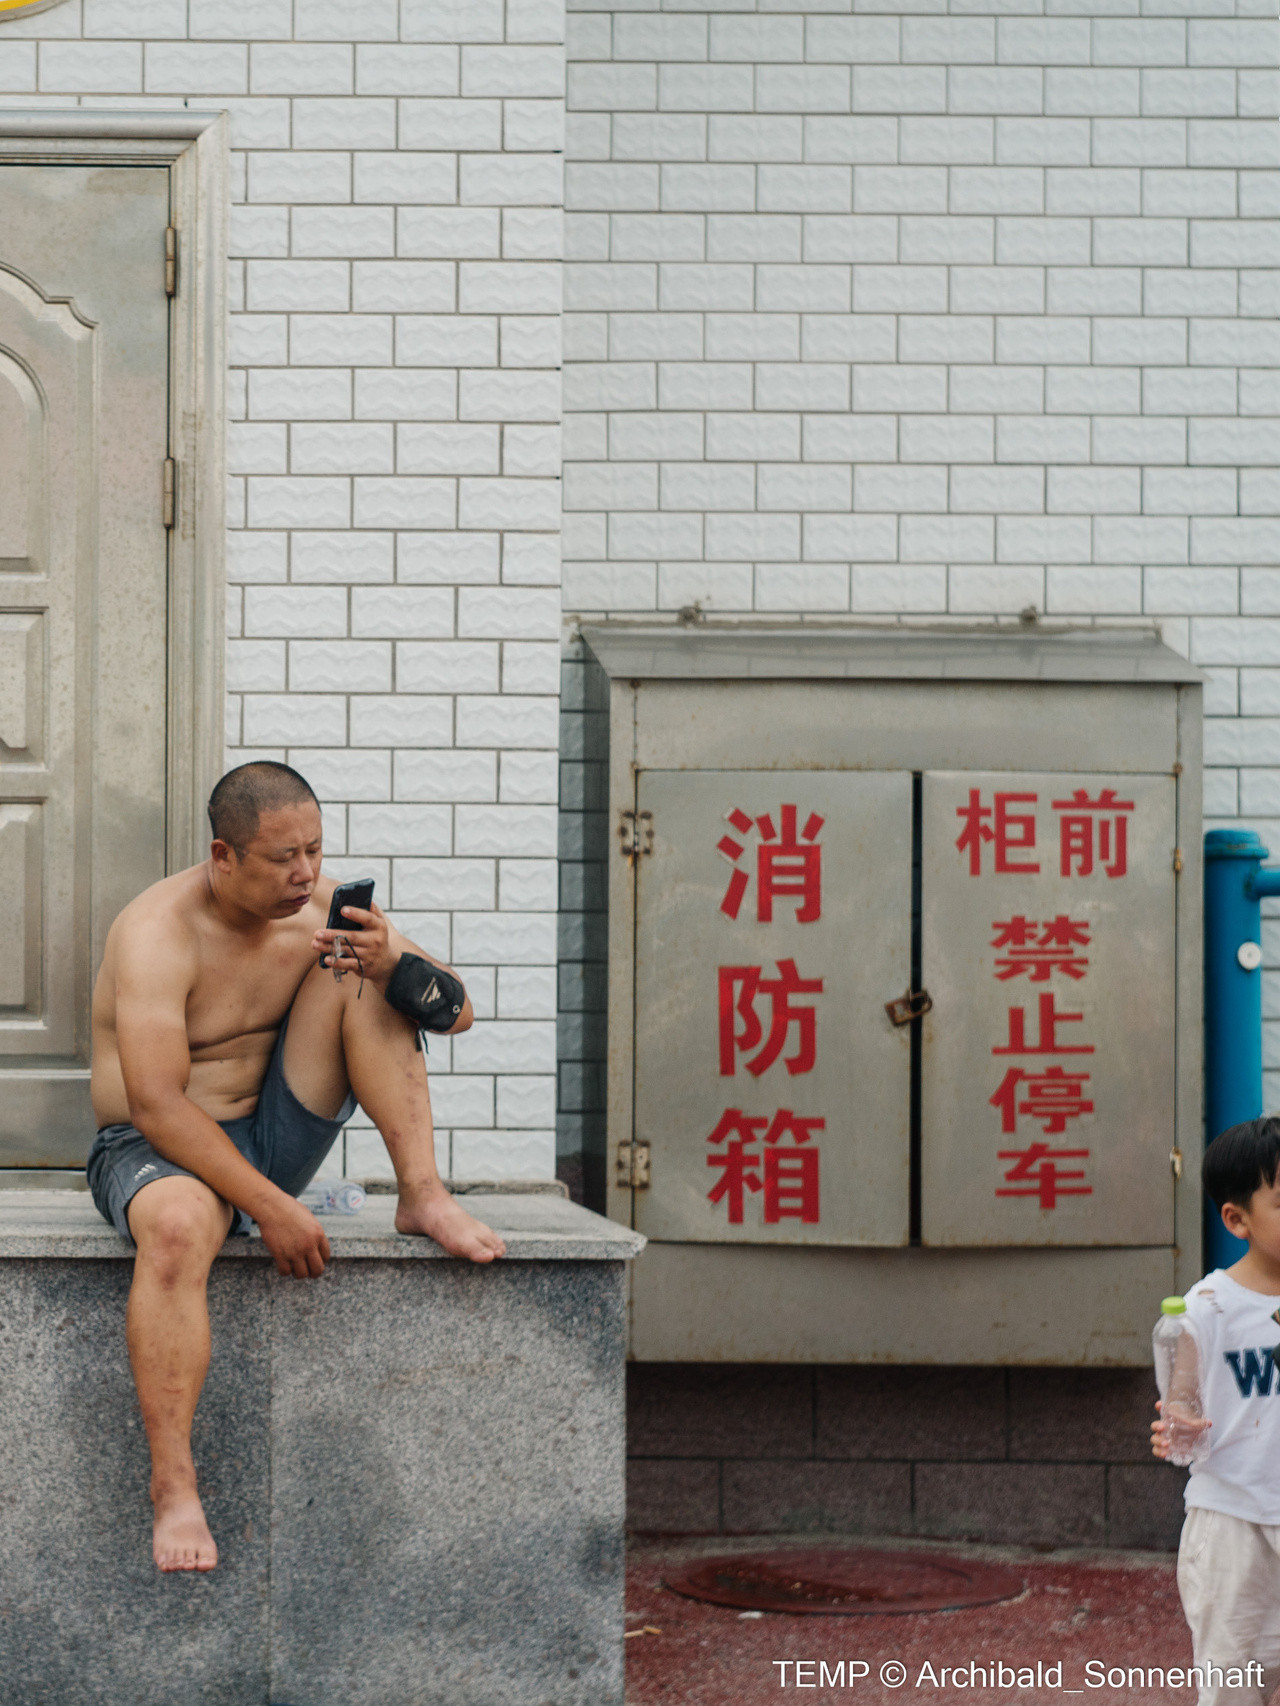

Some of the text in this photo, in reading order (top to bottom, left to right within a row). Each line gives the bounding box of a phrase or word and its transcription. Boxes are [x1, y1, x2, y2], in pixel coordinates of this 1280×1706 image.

[955, 788, 1135, 879] 柜前
[706, 803, 826, 1225] 消防箱
[989, 915, 1095, 1210] 禁止停车
